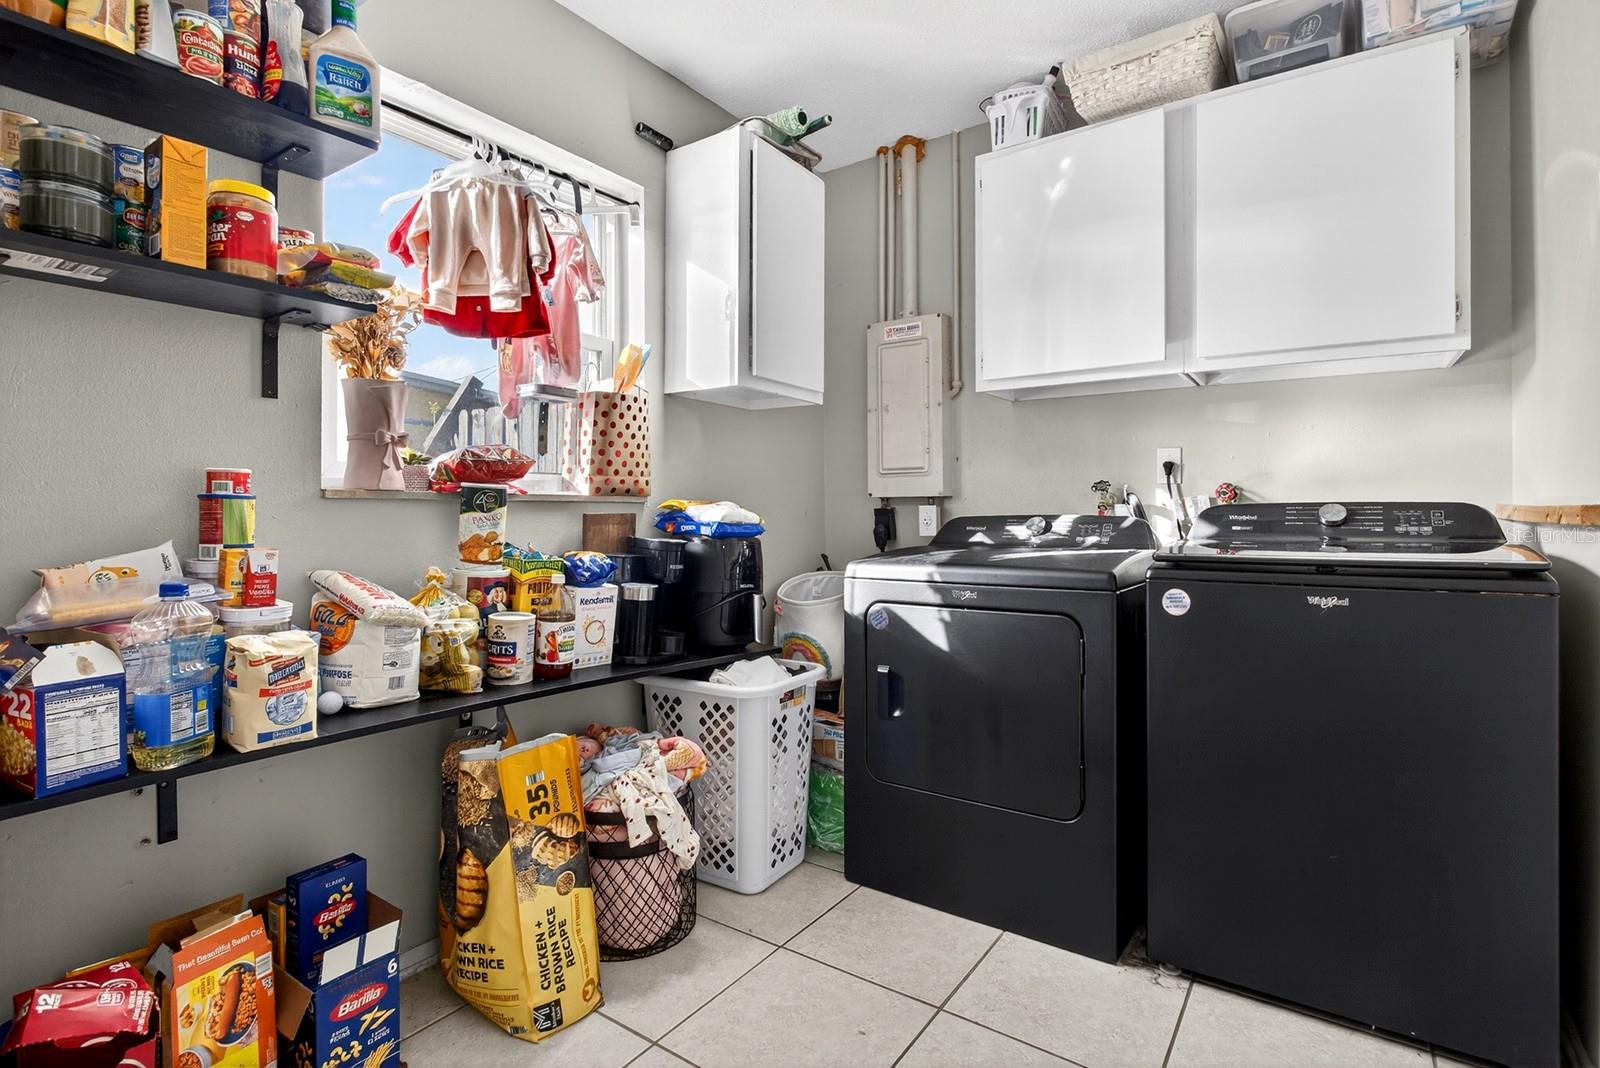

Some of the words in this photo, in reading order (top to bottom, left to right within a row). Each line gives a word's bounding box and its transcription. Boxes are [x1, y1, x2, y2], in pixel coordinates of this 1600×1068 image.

[329, 73, 361, 90] Ranch
[579, 595, 614, 606] Kendamil
[1307, 595, 1349, 609] Whirlpool
[8, 692, 32, 720] 22
[527, 784, 551, 821] 35
[535, 920, 543, 929] +
[546, 906, 557, 938] RICE
[488, 946, 495, 954] +
[558, 918, 576, 968] RECIPE
[387, 958, 398, 974] 6
[478, 959, 504, 970] RICE
[535, 931, 551, 991] CHICKEN
[550, 940, 566, 994] BROWN
[338, 987, 384, 1018] Barilla
